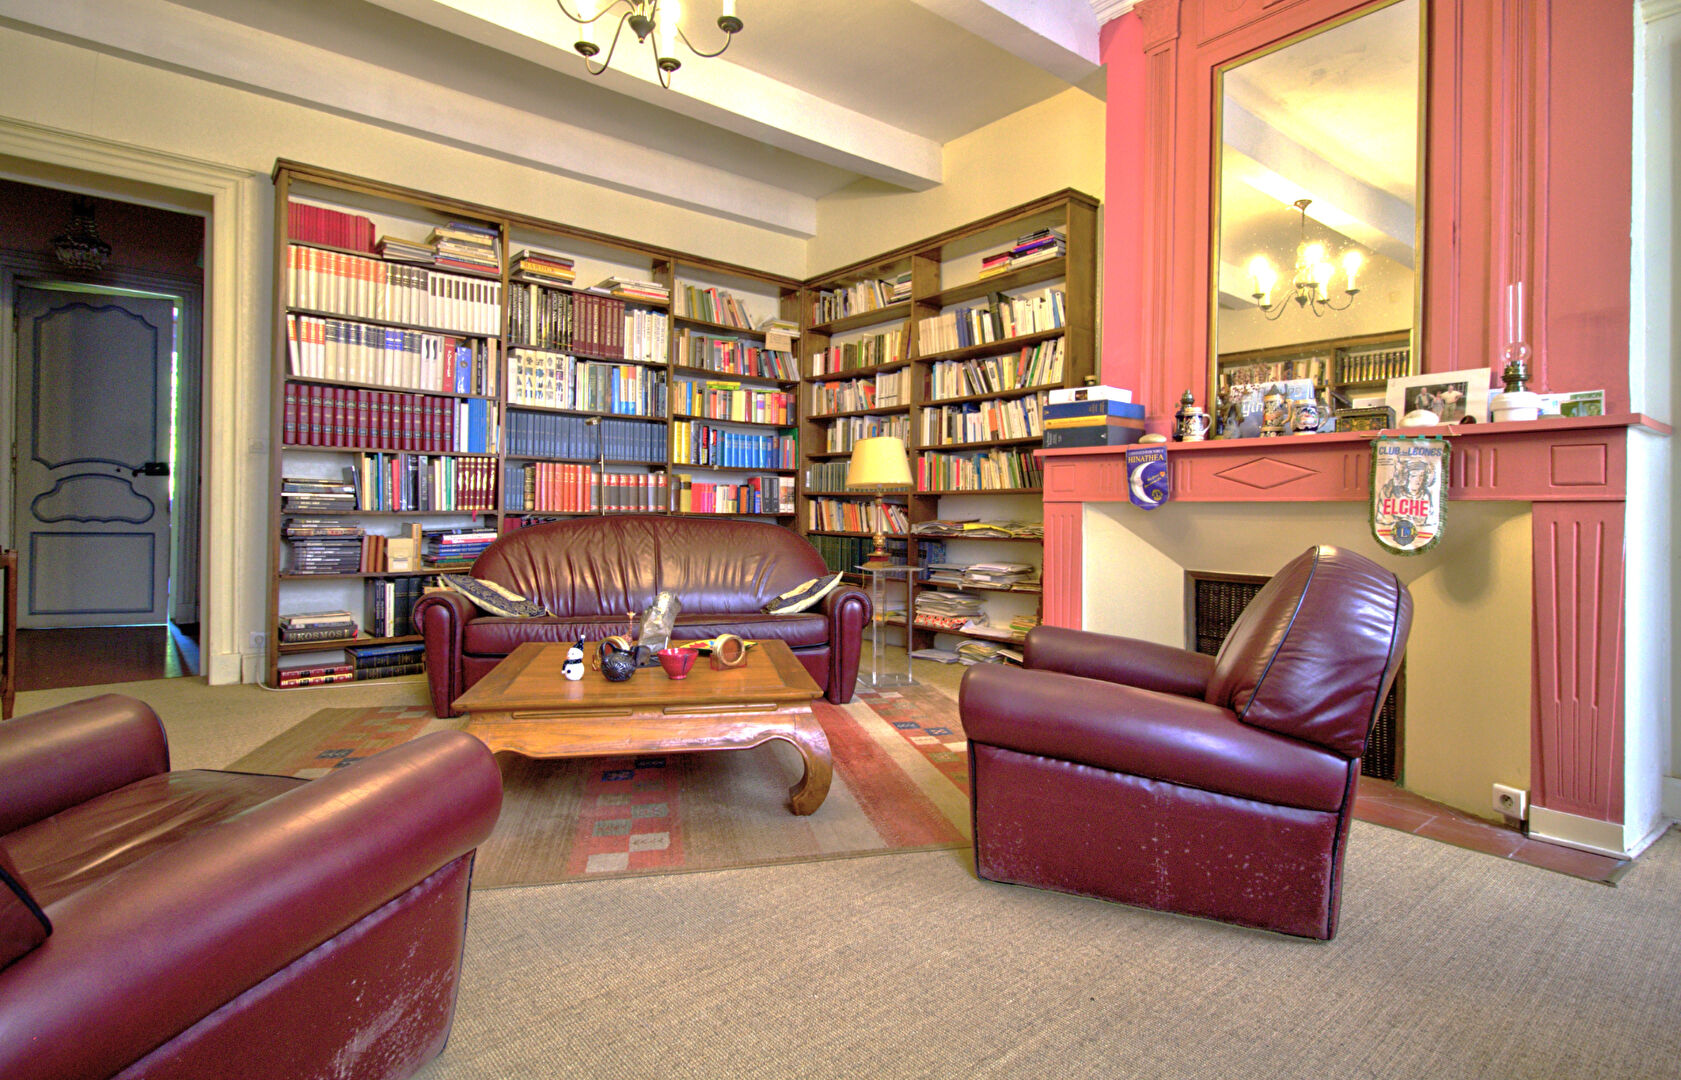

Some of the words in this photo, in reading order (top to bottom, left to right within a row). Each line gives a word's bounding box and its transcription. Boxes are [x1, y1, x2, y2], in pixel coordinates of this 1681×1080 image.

[1379, 446, 1400, 455] CLUB
[1408, 447, 1442, 456] LEONES
[1383, 499, 1428, 517] ELCHE
